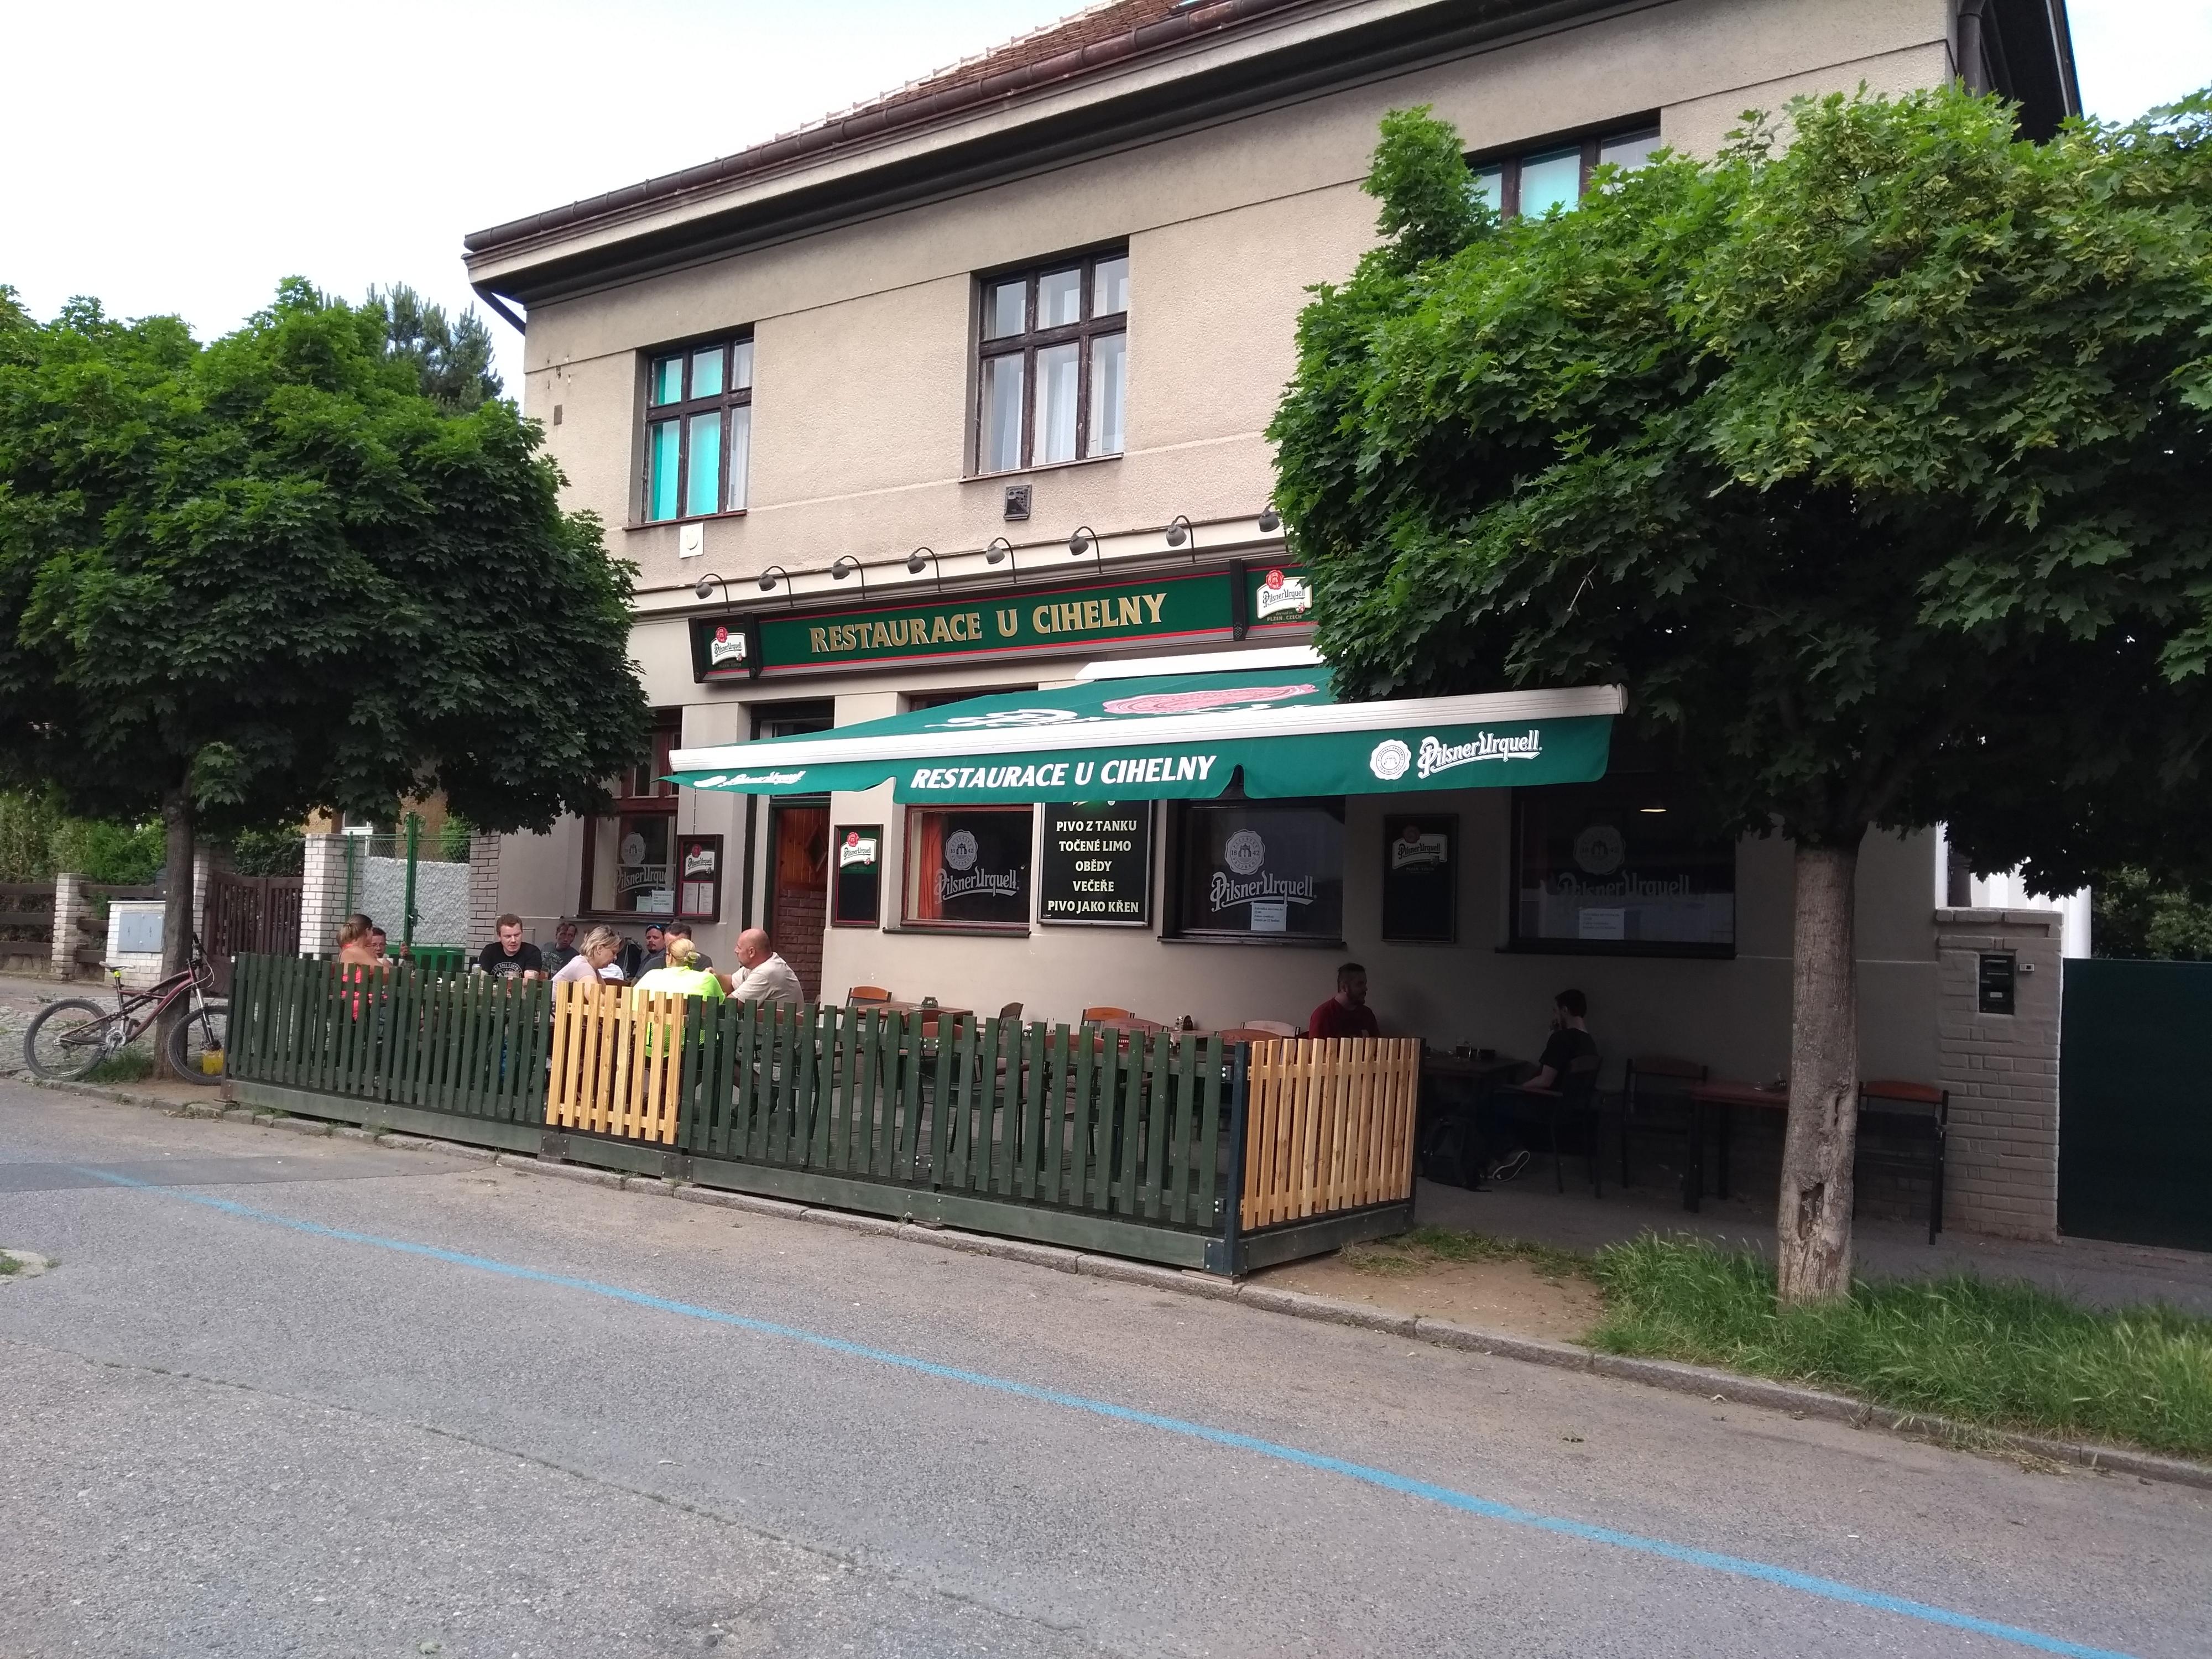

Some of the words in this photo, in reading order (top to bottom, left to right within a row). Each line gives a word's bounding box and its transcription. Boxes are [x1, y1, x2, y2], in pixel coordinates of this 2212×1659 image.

[1262, 591, 1284, 608] Pilsner
[1284, 588, 1305, 601] Urquell
[810, 612, 983, 654] RESTAURACE
[996, 609, 1019, 638] U
[1032, 592, 1167, 634] CIHELNY
[714, 643, 728, 657] Pilsner
[727, 641, 742, 652] Urquell
[1417, 735, 1480, 779] Pilsner
[1478, 729, 1540, 763] Urquell
[910, 763, 1070, 789] RESTAURACE
[1074, 762, 1094, 785] U
[1100, 755, 1217, 785] CIHELNY
[1056, 821, 1083, 832] PIVO
[1087, 821, 1093, 831] Z
[1095, 820, 1137, 831] TANKU
[1059, 838, 1100, 852] TOČENÉ
[1103, 840, 1132, 852] LIMO
[1419, 843, 1441, 854] Urquell
[1075, 859, 1113, 872] OBĚDY
[933, 868, 977, 905] Pilsner
[975, 866, 1016, 897] Urquell
[1073, 879, 1114, 892] VEČEŘE
[1210, 872, 1264, 912] Pilsner
[1261, 870, 1313, 905] Urquell
[1048, 900, 1075, 911] PIVO
[1076, 901, 1105, 915] JAKO
[1108, 900, 1139, 913] KŘEN
